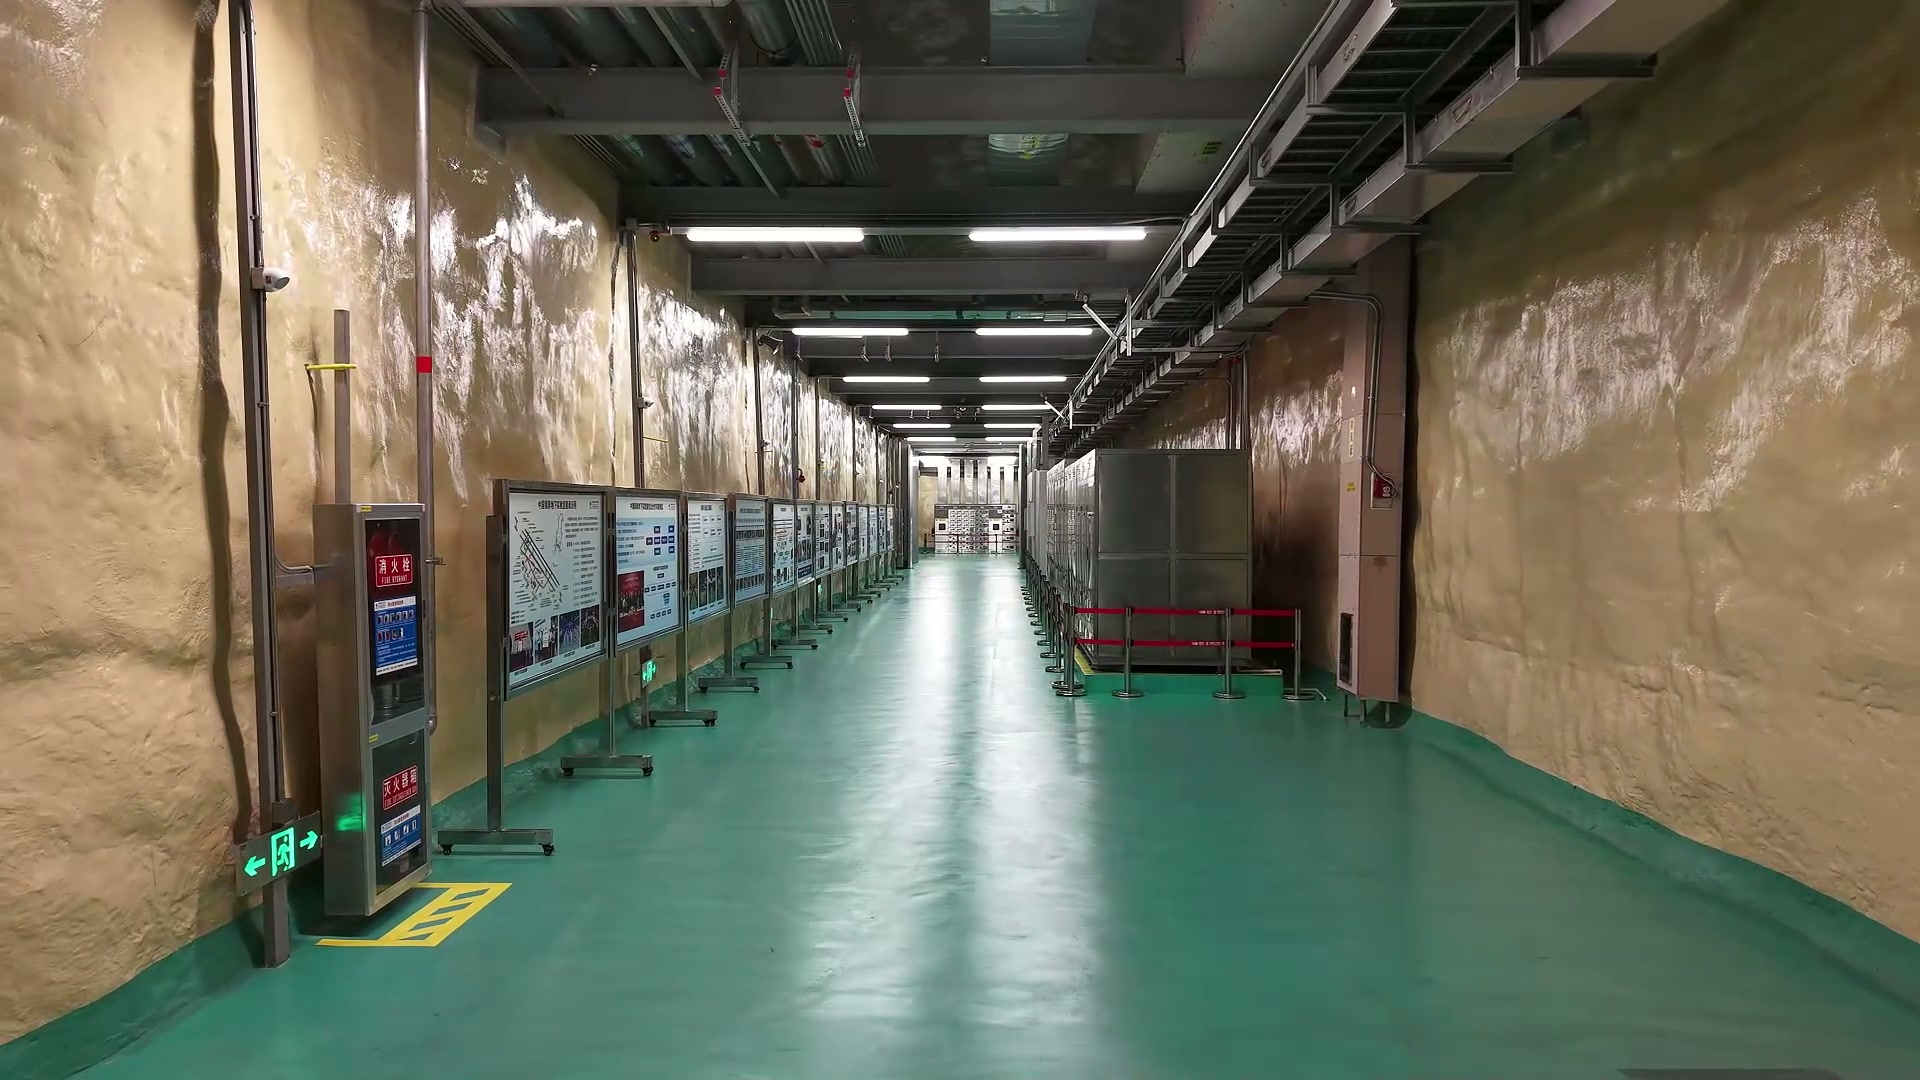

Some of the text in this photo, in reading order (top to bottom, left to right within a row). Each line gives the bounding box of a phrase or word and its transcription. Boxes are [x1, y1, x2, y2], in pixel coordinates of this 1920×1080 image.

[379, 557, 410, 574] 消火栓
[382, 576, 391, 584] FIRE
[384, 769, 416, 797] 灭火器箱
